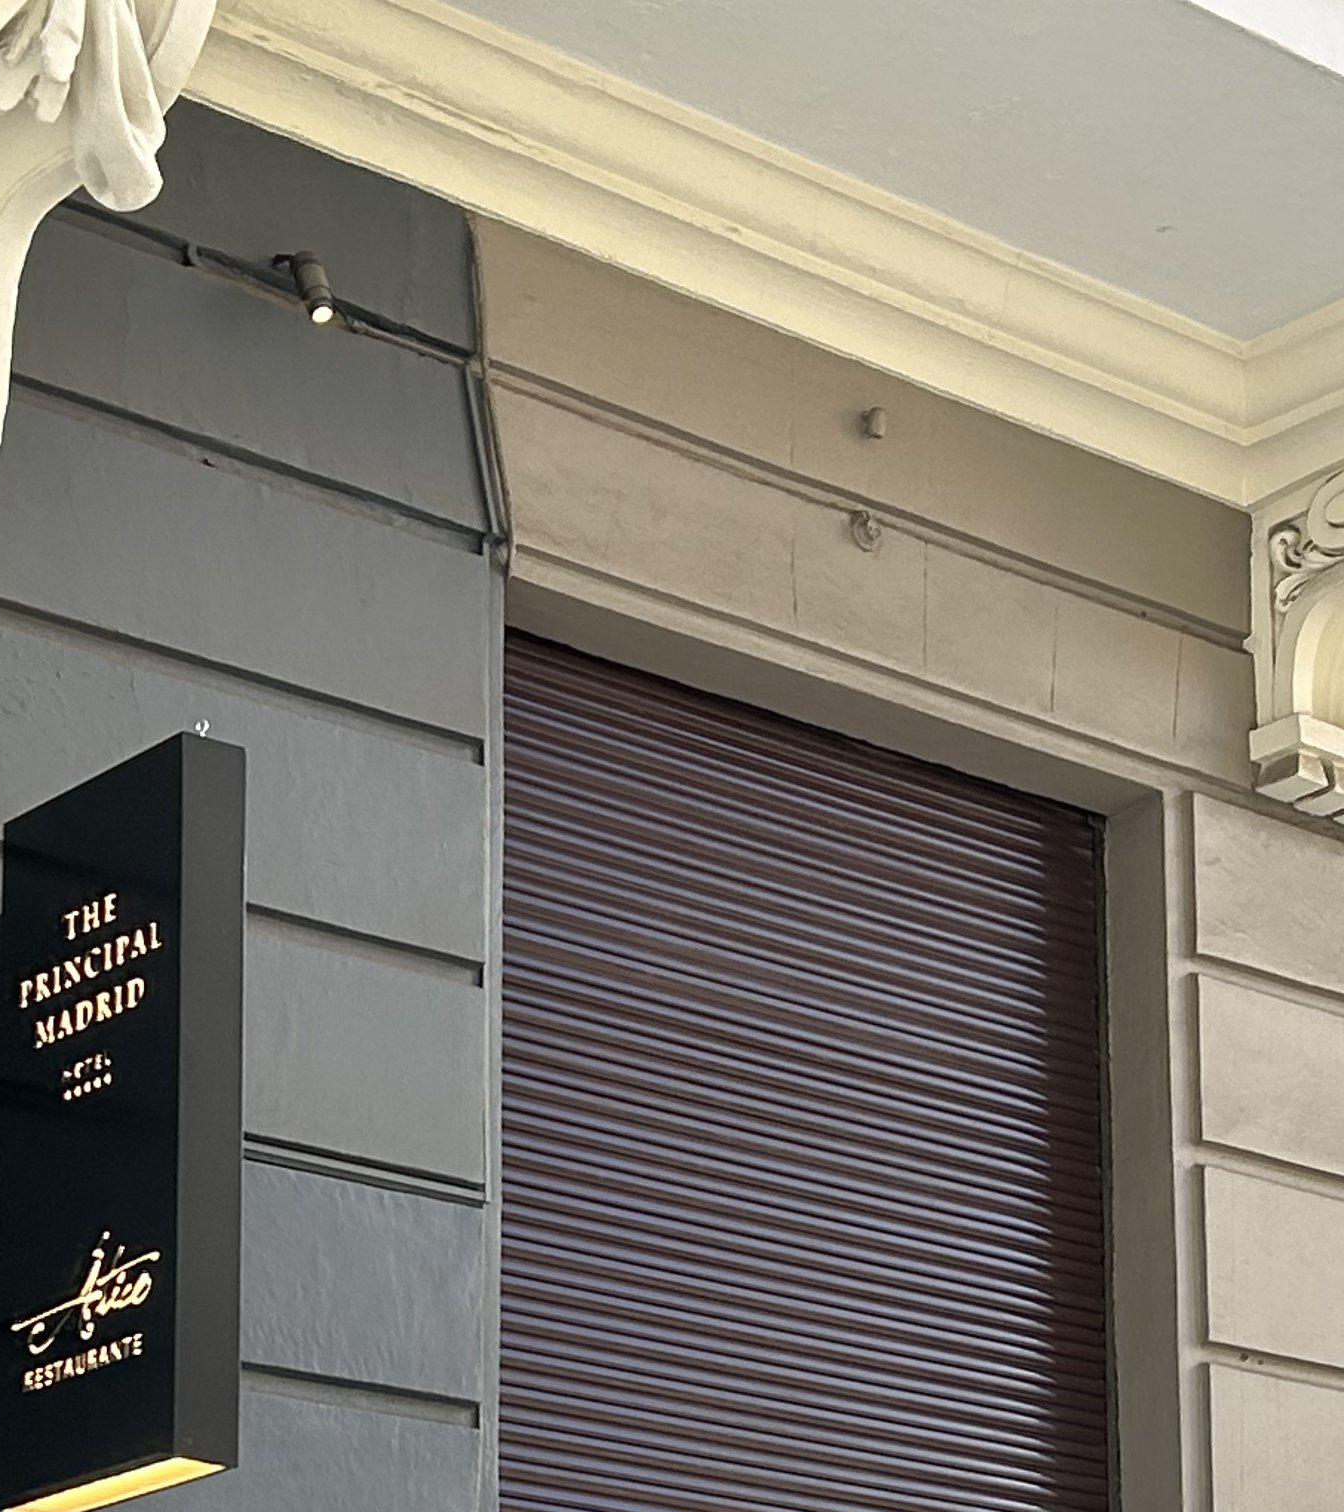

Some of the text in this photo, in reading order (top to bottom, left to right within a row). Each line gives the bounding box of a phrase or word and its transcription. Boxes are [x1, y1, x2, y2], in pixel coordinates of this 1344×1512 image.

[63, 892, 117, 940] THE
[19, 921, 162, 1008] PRINCIPAL
[33, 977, 145, 1049] MADRID
[22, 1333, 143, 1392] RESTAURANTE
